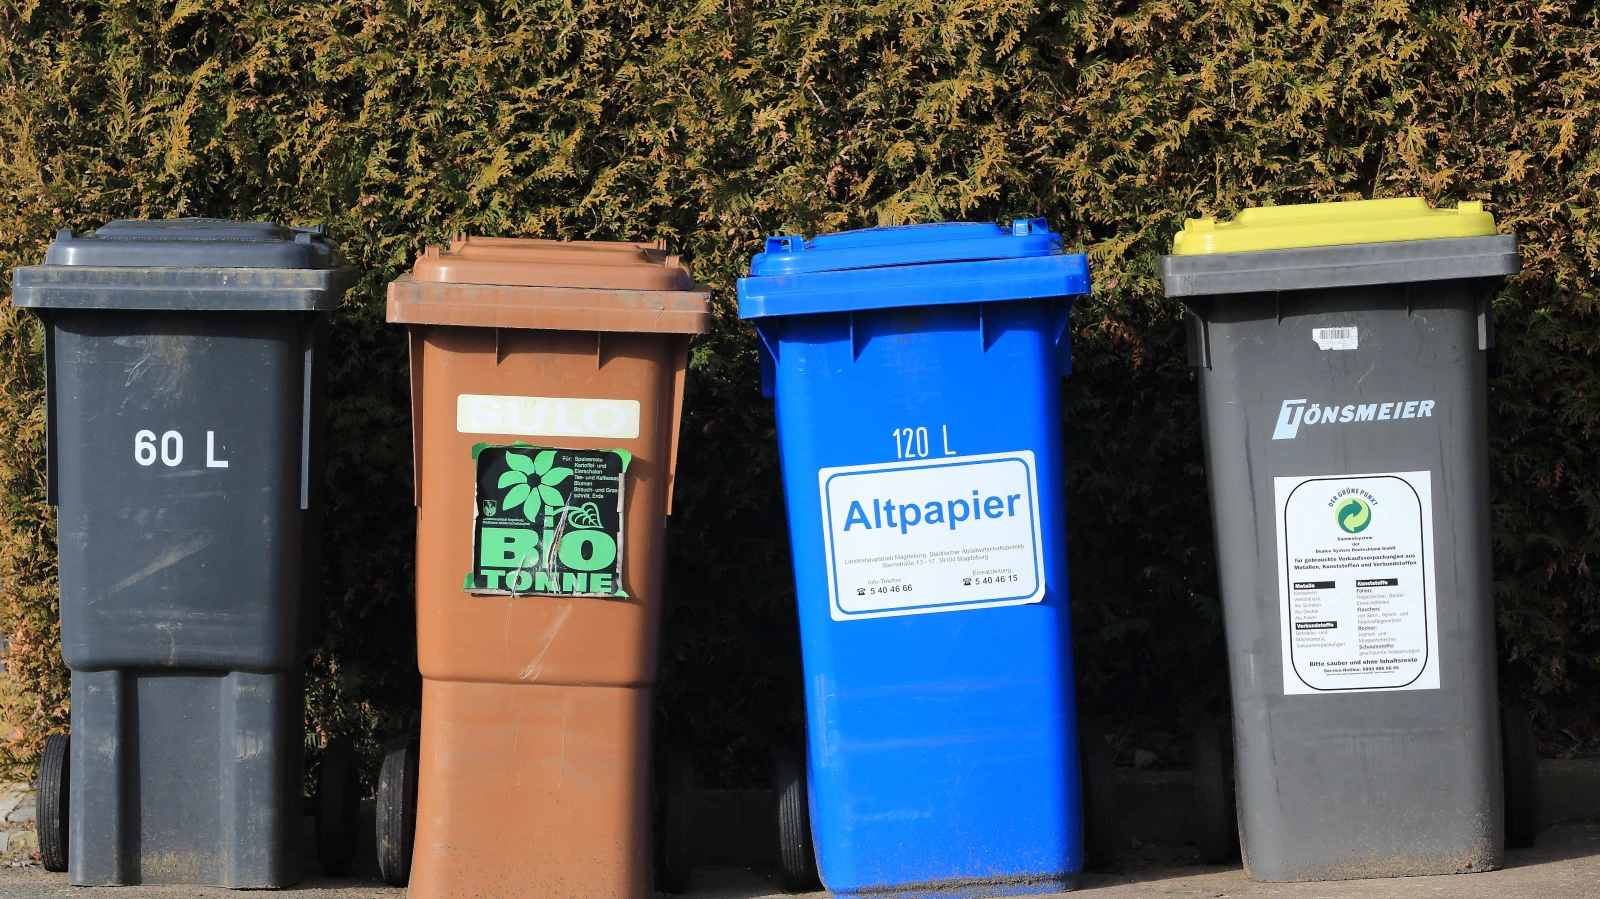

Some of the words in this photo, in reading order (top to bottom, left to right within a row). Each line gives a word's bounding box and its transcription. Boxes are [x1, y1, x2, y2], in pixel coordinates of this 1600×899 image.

[467, 397, 626, 435] SULO
[1272, 399, 1435, 440] TÖNSMEIER
[135, 430, 183, 466] 60
[206, 431, 228, 467] L
[893, 427, 929, 458] 120
[942, 425, 956, 455] L
[1328, 495, 1339, 507] DER
[1337, 487, 1359, 498] GRÜNE
[1360, 490, 1378, 506] PUNKT
[844, 490, 1021, 534] Altpapier
[844, 556, 894, 565] Landeshauptstadt
[939, 556, 956, 564] 39104
[957, 554, 988, 562] Magdeburg
[1338, 554, 1404, 562] Verkaufsverpackungen
[481, 569, 612, 593] TONNE
[973, 568, 1012, 576] Einsatzleitung
[1008, 574, 1018, 582] 15
[870, 587, 875, 595] 5
[878, 586, 888, 594] 40
[890, 585, 900, 593] 46
[902, 584, 912, 592] 66
